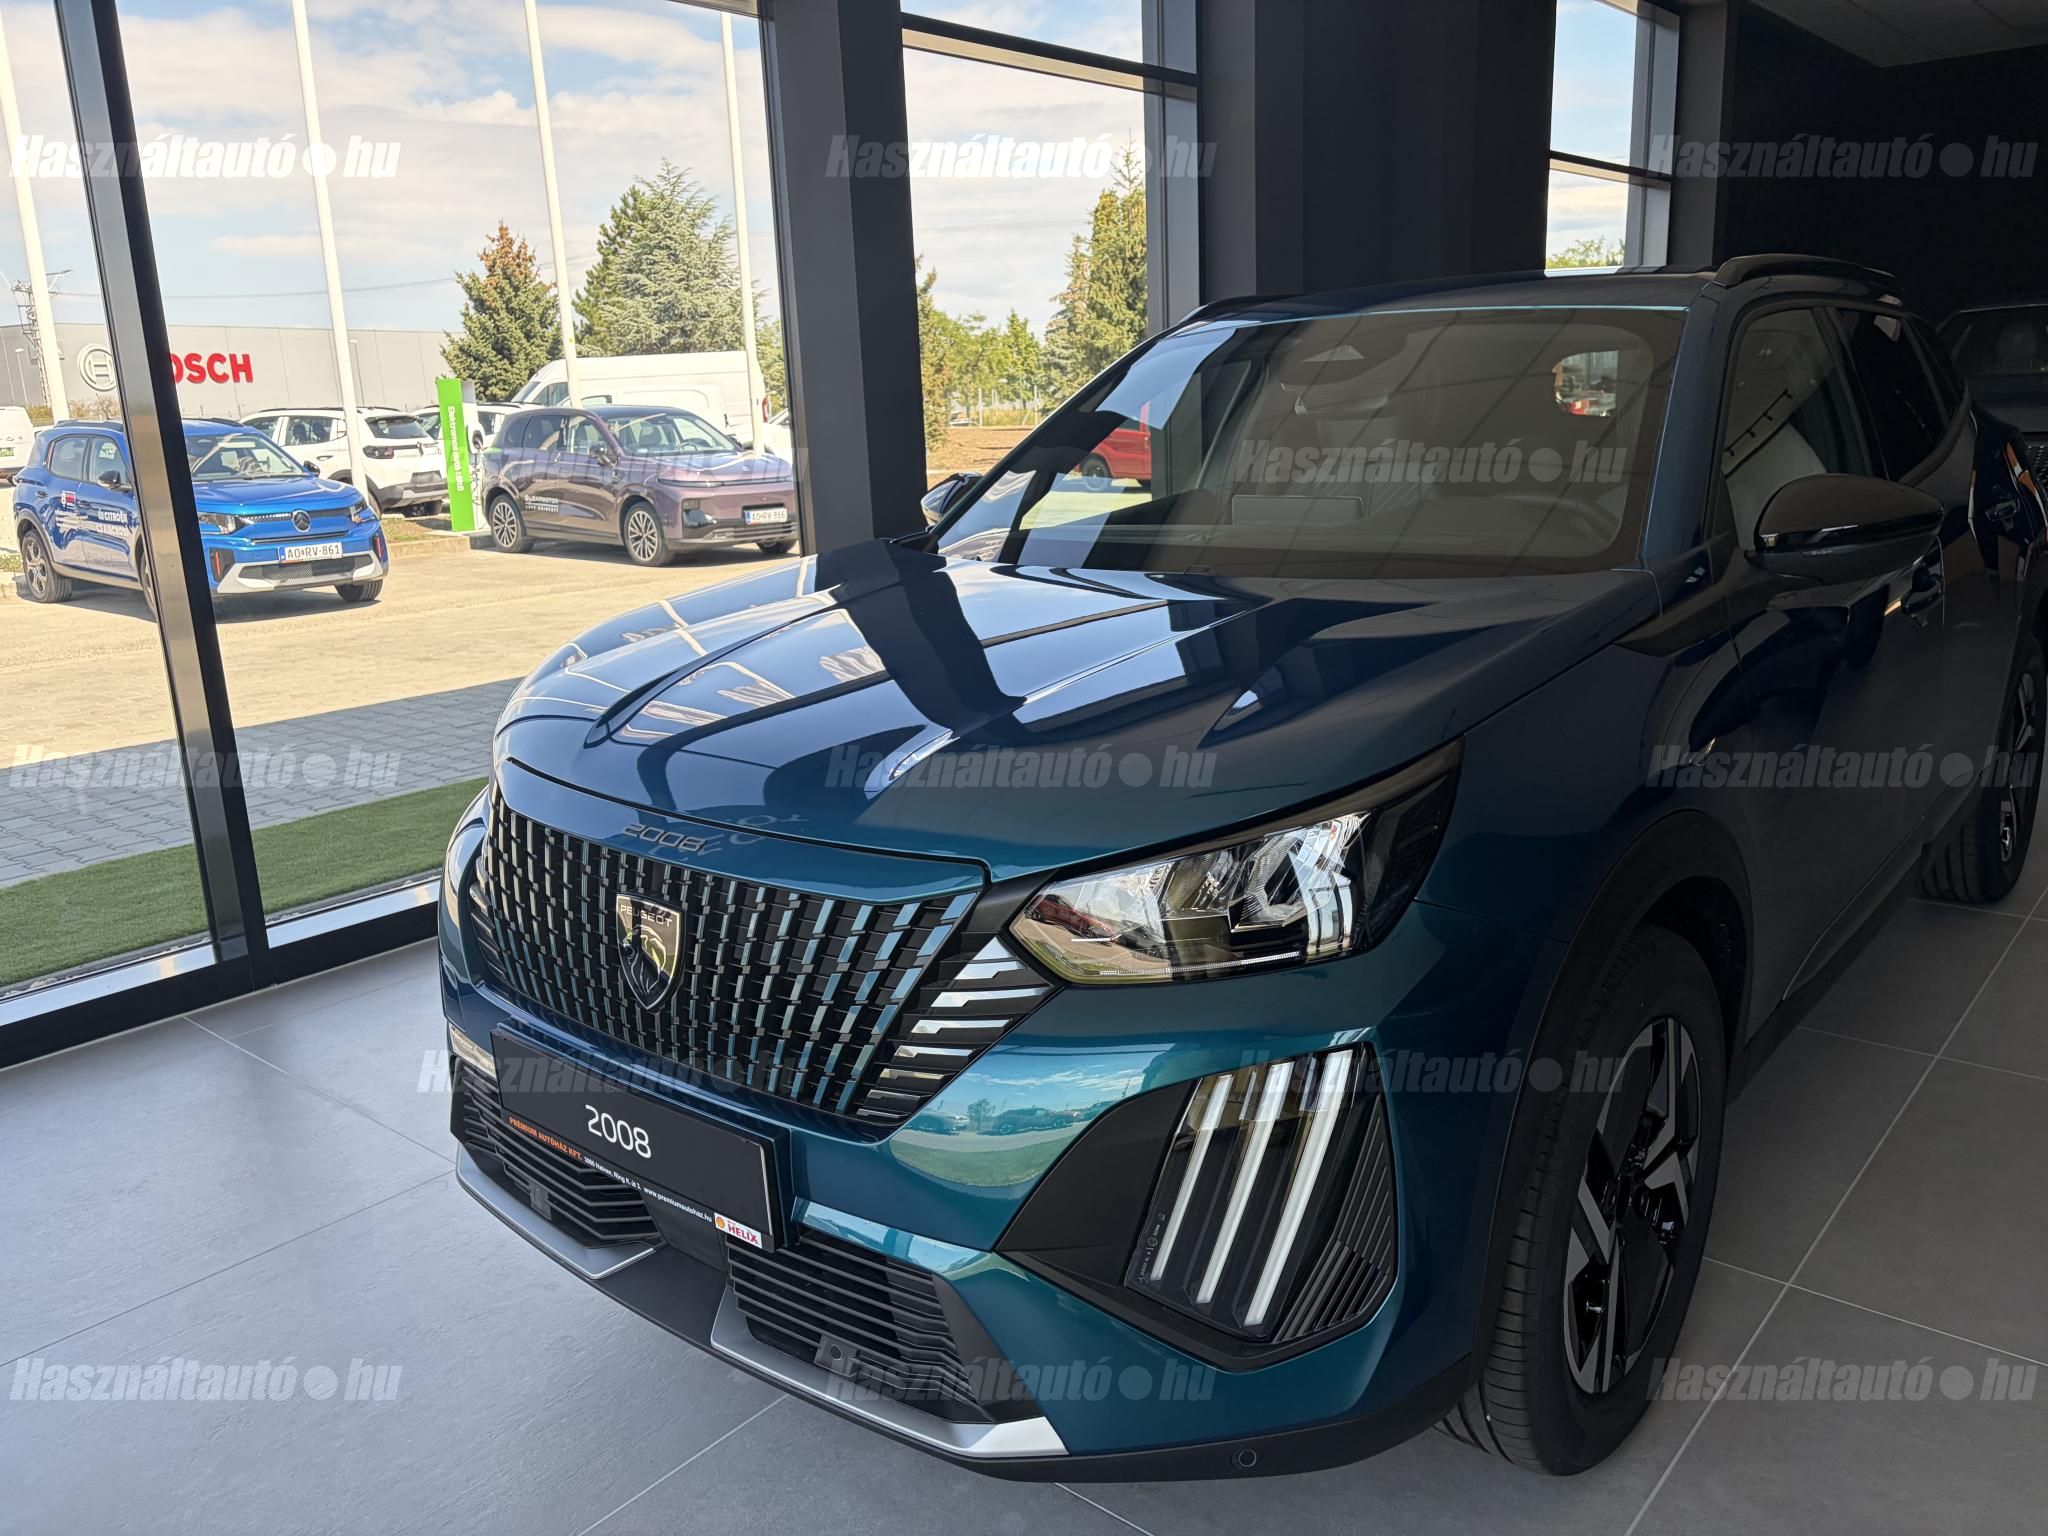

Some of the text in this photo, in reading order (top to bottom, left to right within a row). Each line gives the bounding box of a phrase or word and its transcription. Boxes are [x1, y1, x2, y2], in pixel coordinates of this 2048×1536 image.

[623, 823, 706, 852] 2008
[620, 904, 673, 927] PEUGEOT
[585, 1104, 652, 1158] 2008
[728, 1223, 758, 1245] HELIX
